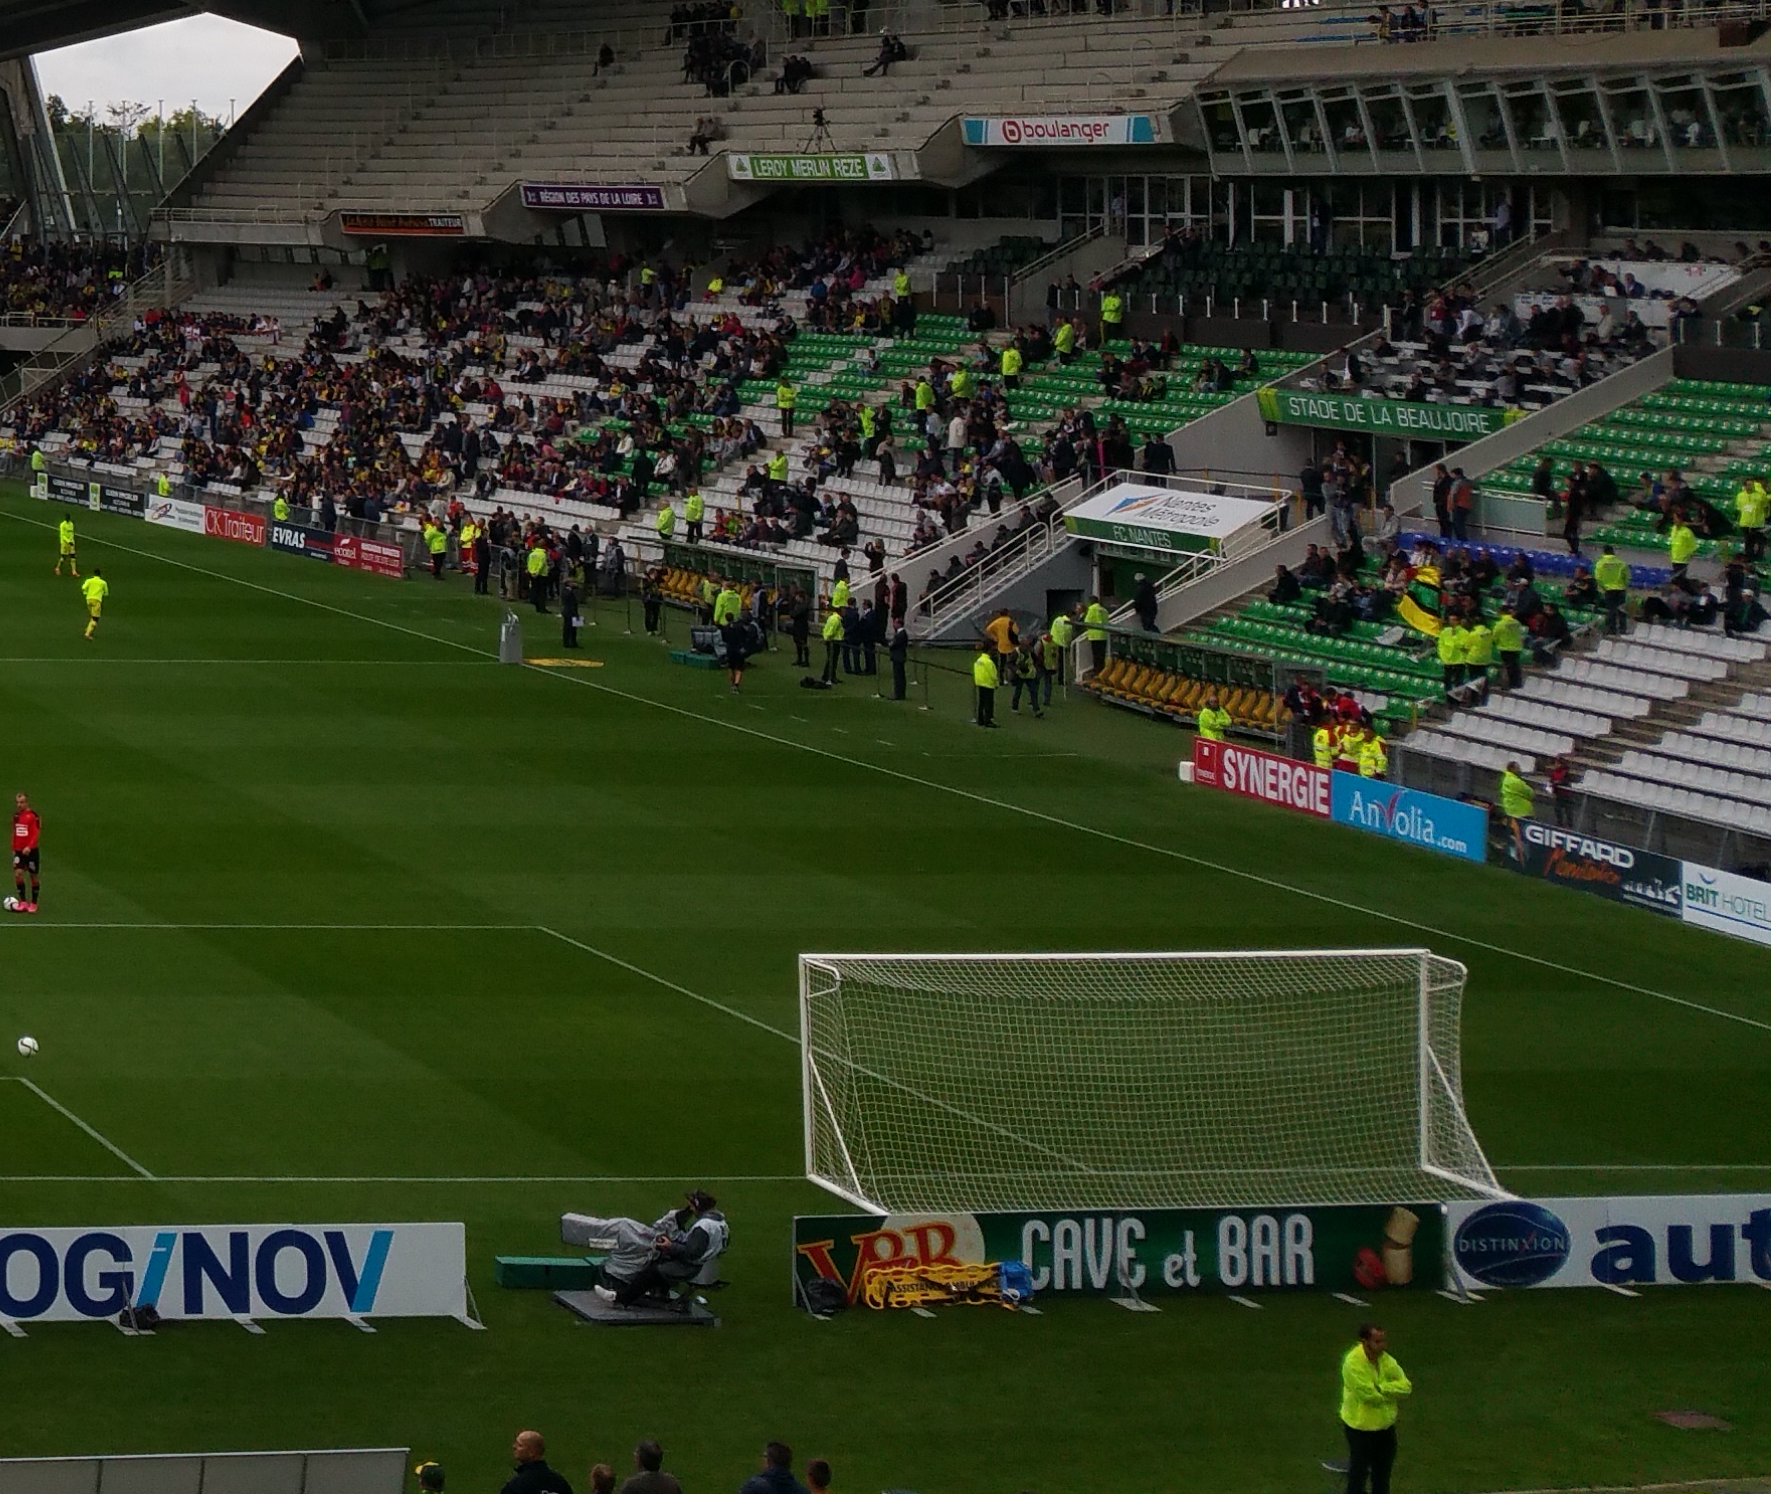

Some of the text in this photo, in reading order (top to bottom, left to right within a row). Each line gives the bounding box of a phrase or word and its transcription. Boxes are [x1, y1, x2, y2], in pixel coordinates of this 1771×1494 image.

[1022, 120, 1109, 142] boulanger
[756, 159, 787, 177] LEROY
[792, 159, 830, 177] MERLIN
[565, 191, 579, 203] DES
[580, 191, 598, 204] PAYS
[599, 192, 610, 204] DE
[611, 193, 620, 205] LA
[622, 193, 643, 205] LOIRE
[1289, 396, 1492, 434] STADE DE LA BEAUJOIRE
[1160, 495, 1216, 513] Nantes
[223, 512, 264, 544] Traiteur
[272, 526, 306, 549] EVRAS
[1112, 525, 1127, 542] FC
[1128, 526, 1172, 549] NANTES
[1223, 748, 1330, 815] SYNERGIE
[1524, 824, 1636, 869] GIFFARD
[1685, 882, 1720, 907] BRIT
[1022, 1213, 1315, 1292] CAVE et BAR
[1458, 1231, 1566, 1254] DISTINXION
